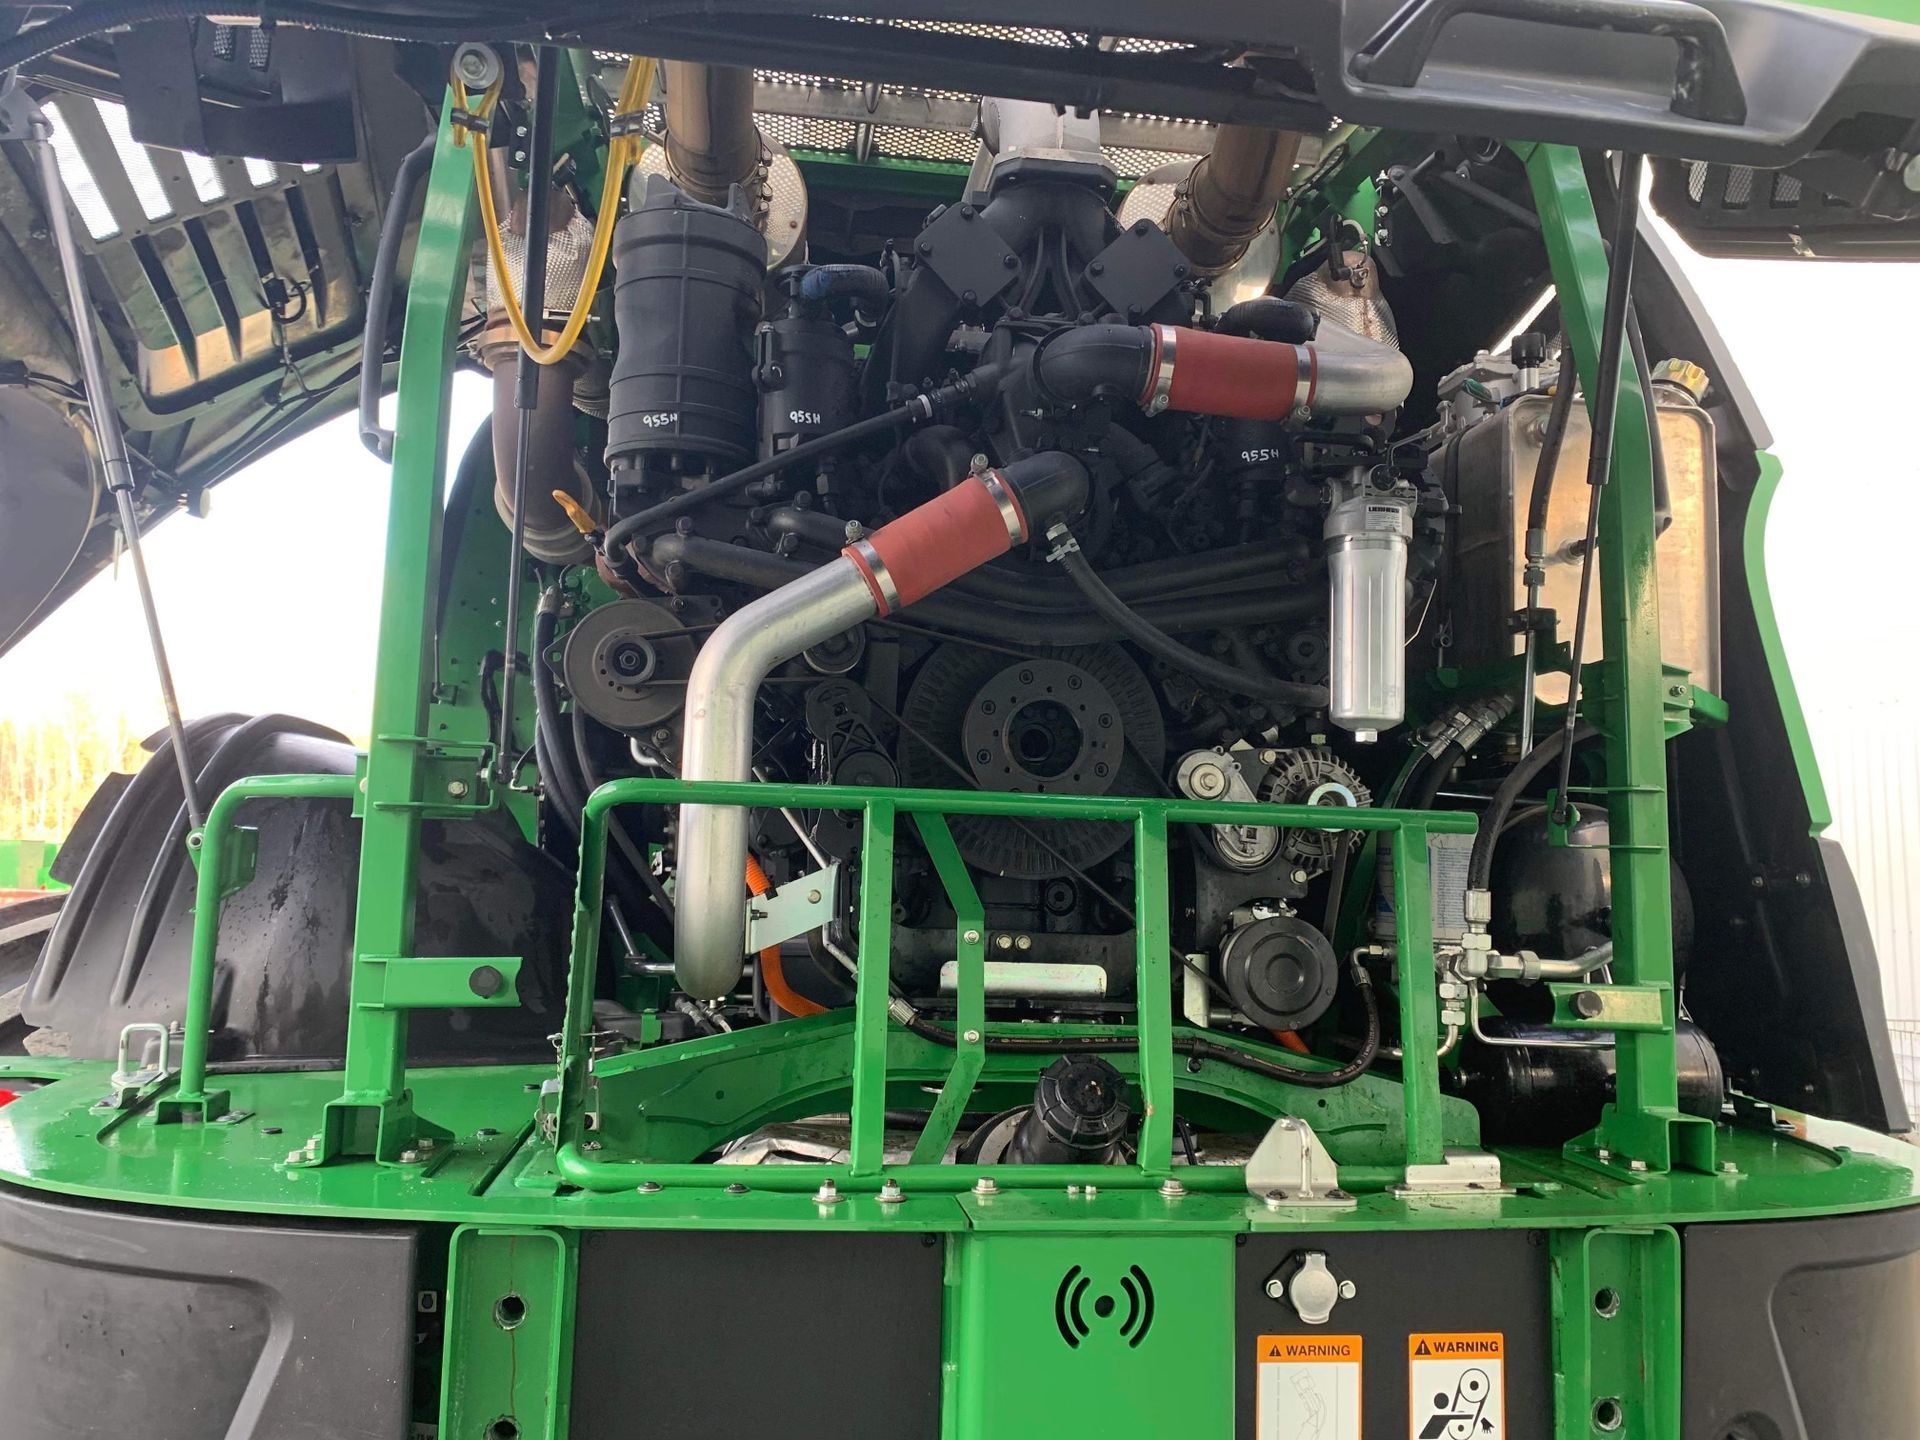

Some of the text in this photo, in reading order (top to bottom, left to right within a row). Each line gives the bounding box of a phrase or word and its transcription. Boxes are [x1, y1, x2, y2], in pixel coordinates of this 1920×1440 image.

[643, 412, 678, 428] 955H
[789, 410, 821, 425] 955H
[1241, 448, 1279, 462] 955H
[1286, 1345, 1351, 1356] WARNING
[1433, 1341, 1499, 1352] WARNING
